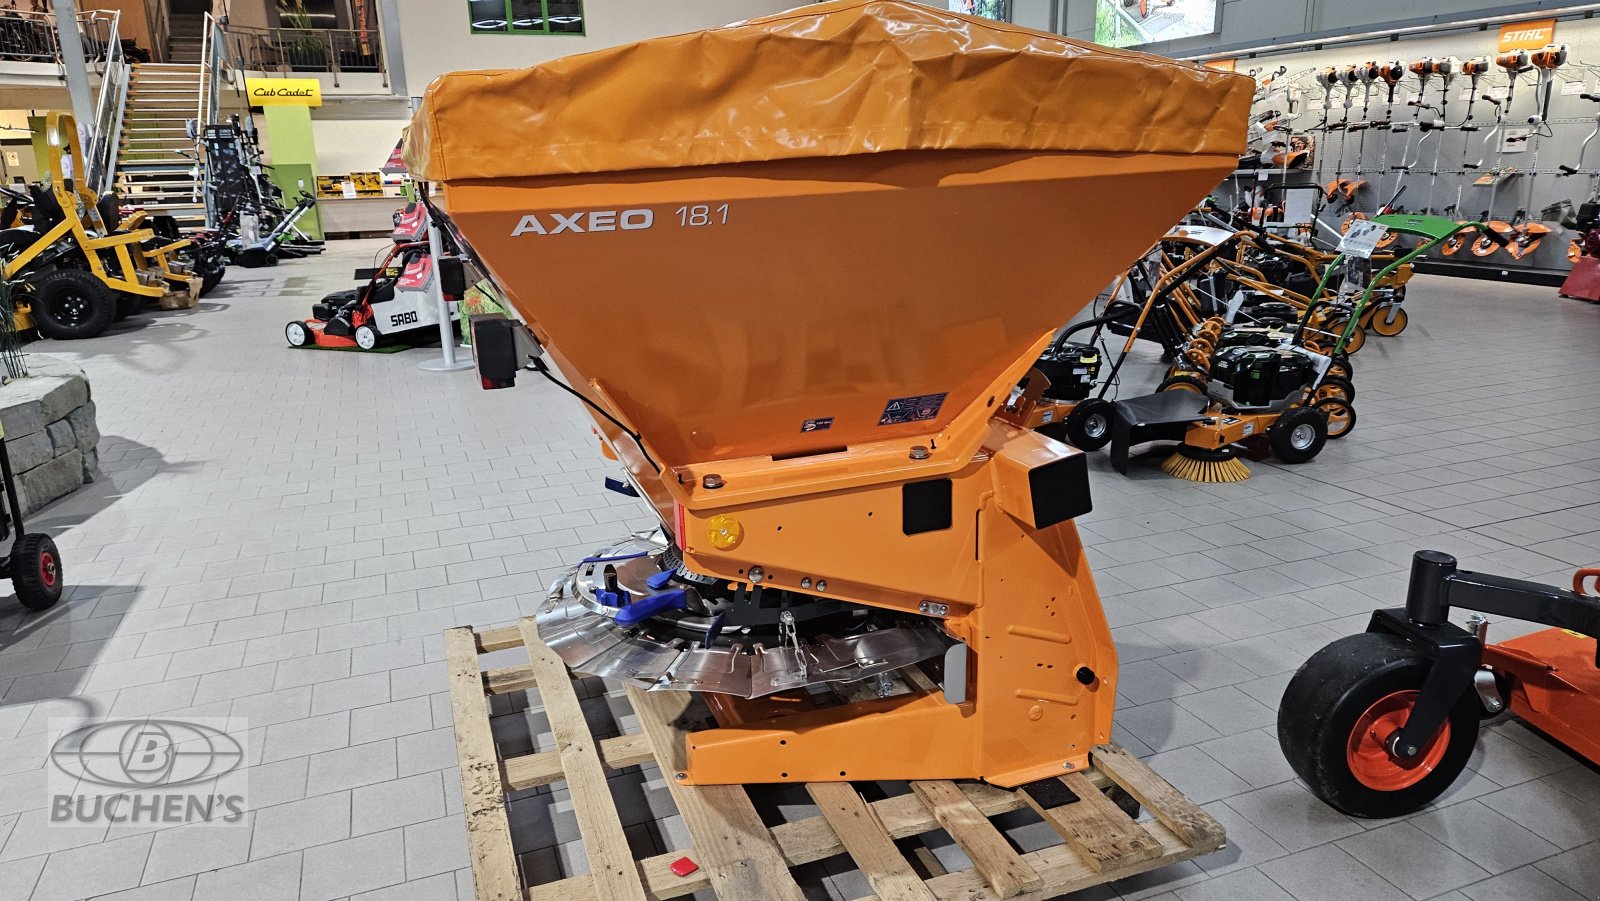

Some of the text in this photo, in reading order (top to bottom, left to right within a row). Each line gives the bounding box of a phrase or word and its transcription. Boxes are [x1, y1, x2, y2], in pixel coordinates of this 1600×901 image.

[1502, 29, 1545, 43] STIHL
[254, 88, 314, 97] Cub Cadet
[510, 203, 731, 237] AXEO 18.1
[390, 310, 418, 327] SABO
